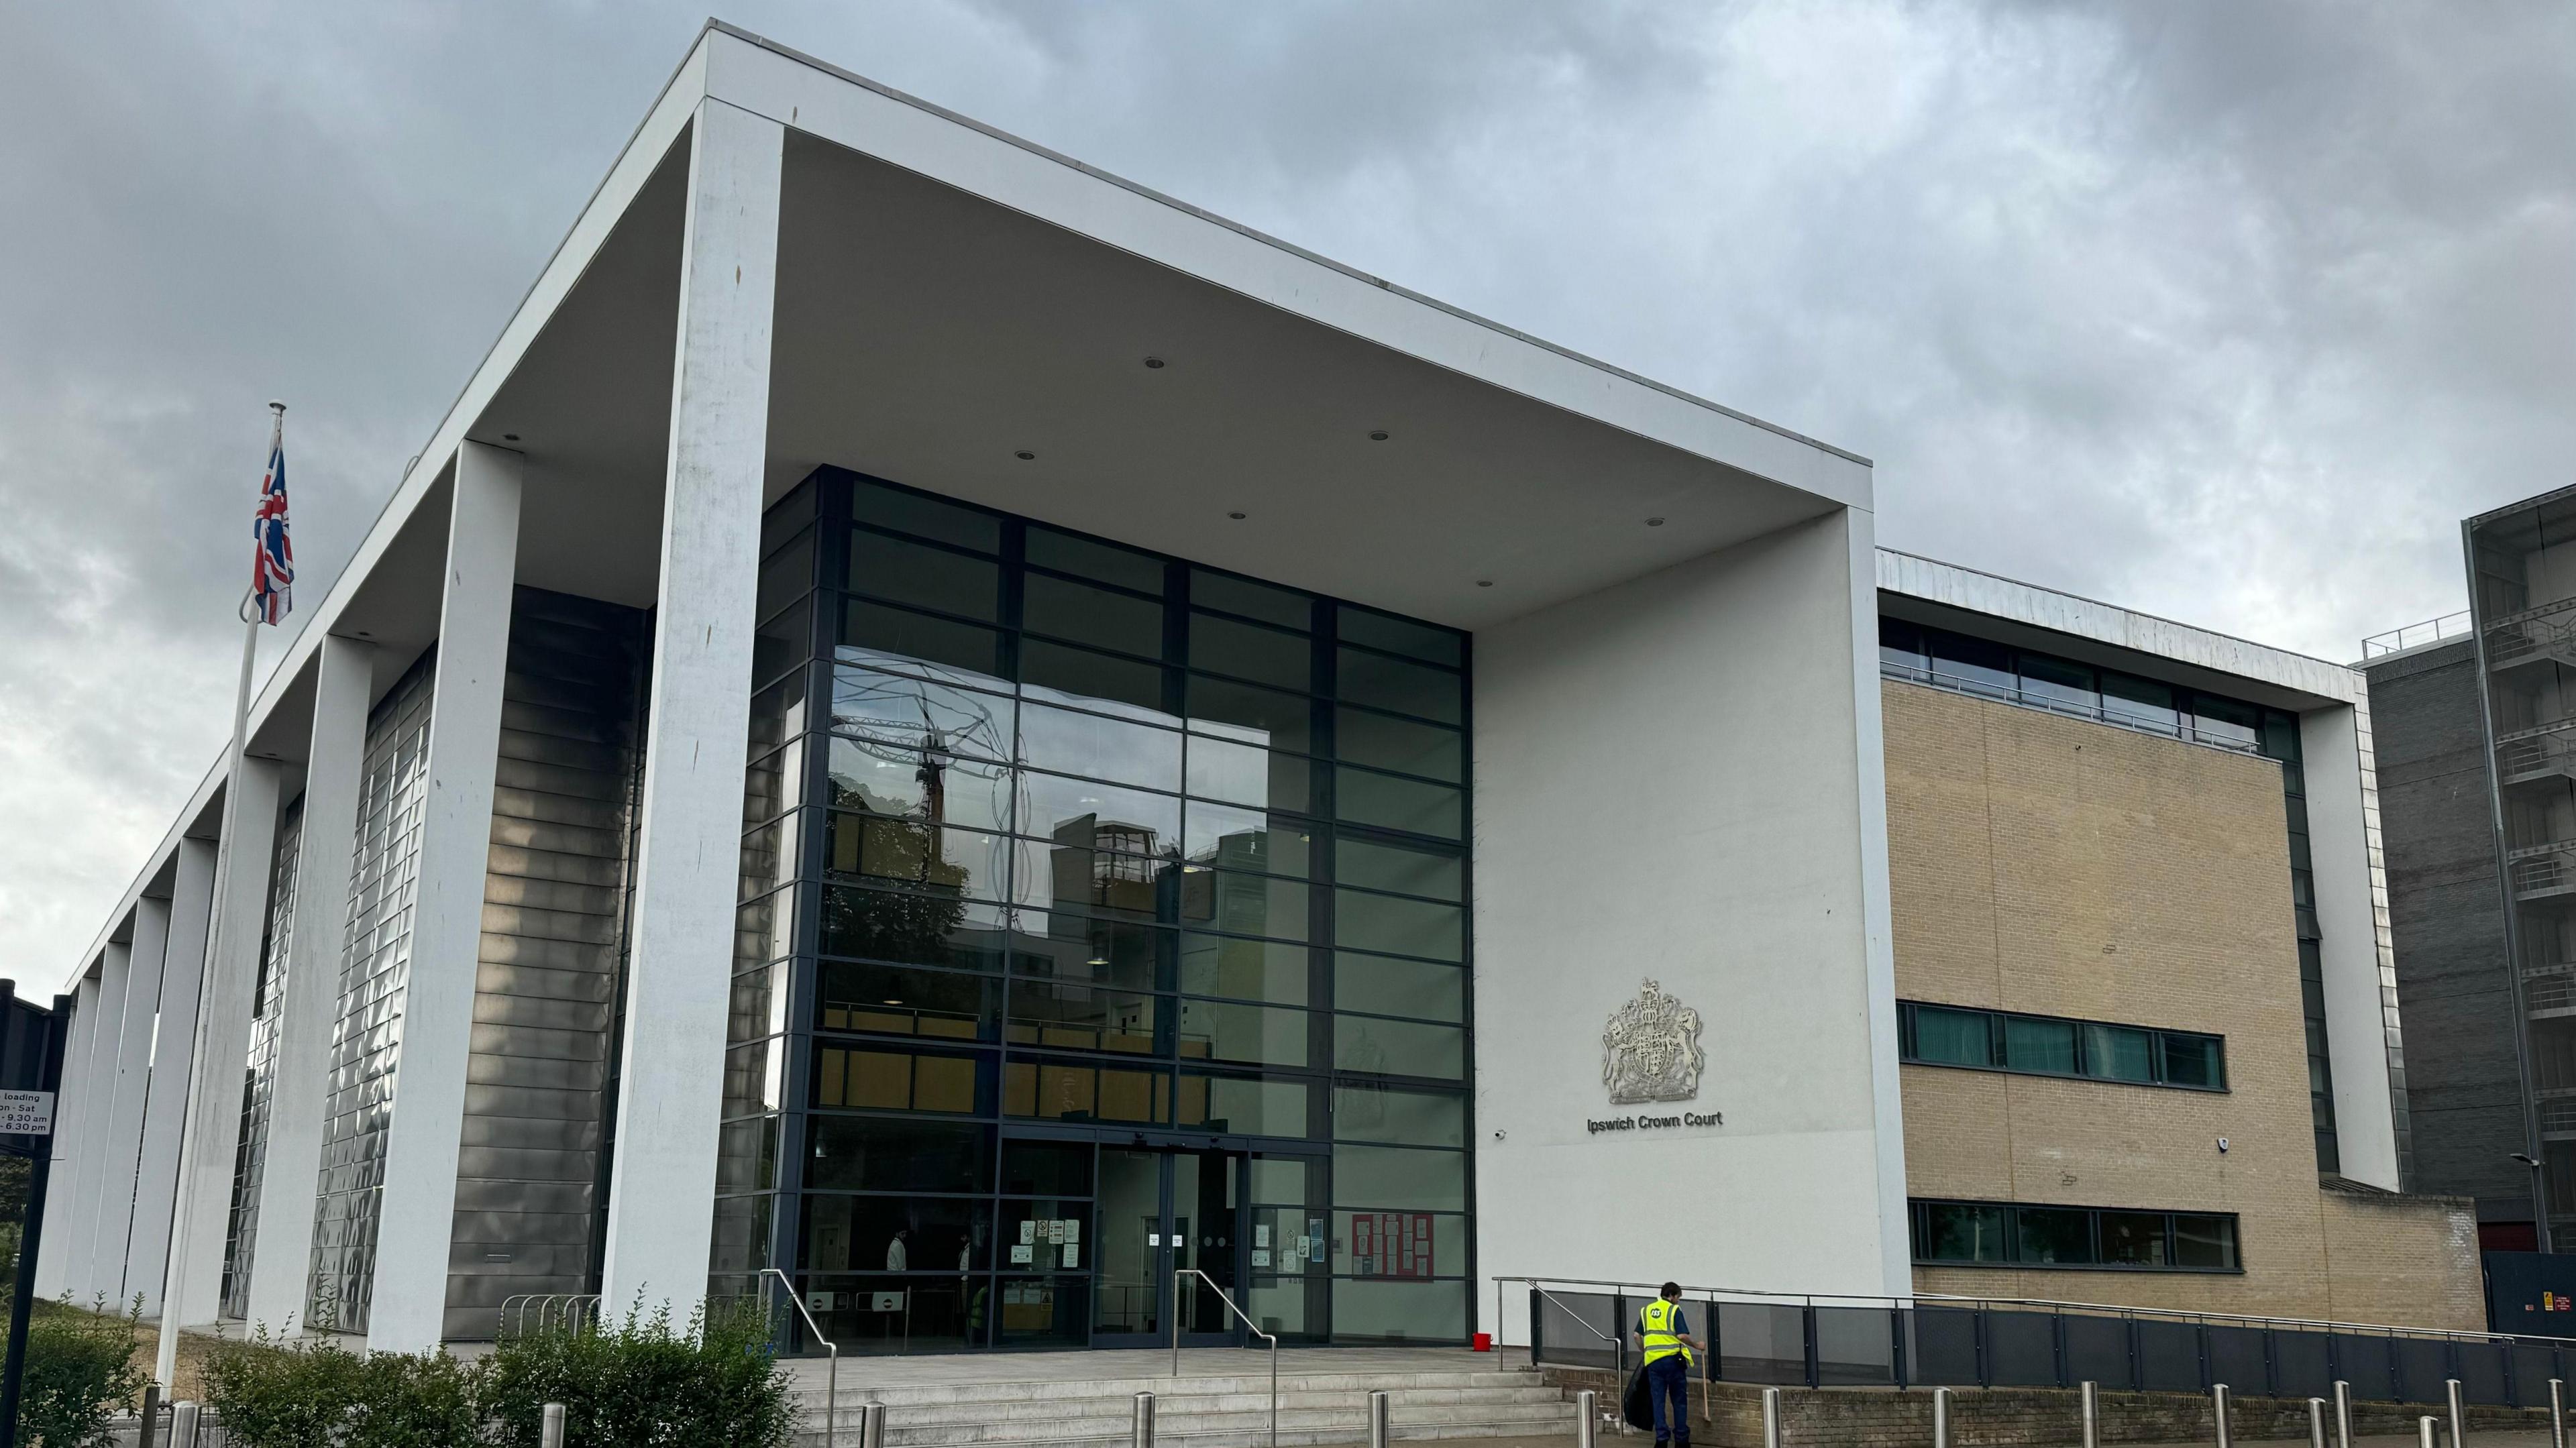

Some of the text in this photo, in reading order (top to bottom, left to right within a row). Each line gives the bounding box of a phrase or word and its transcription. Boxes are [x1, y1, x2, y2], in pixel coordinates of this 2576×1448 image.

[5, 1093, 40, 1102] loading
[1587, 1111, 1723, 1134] Ipswich Crown Court
